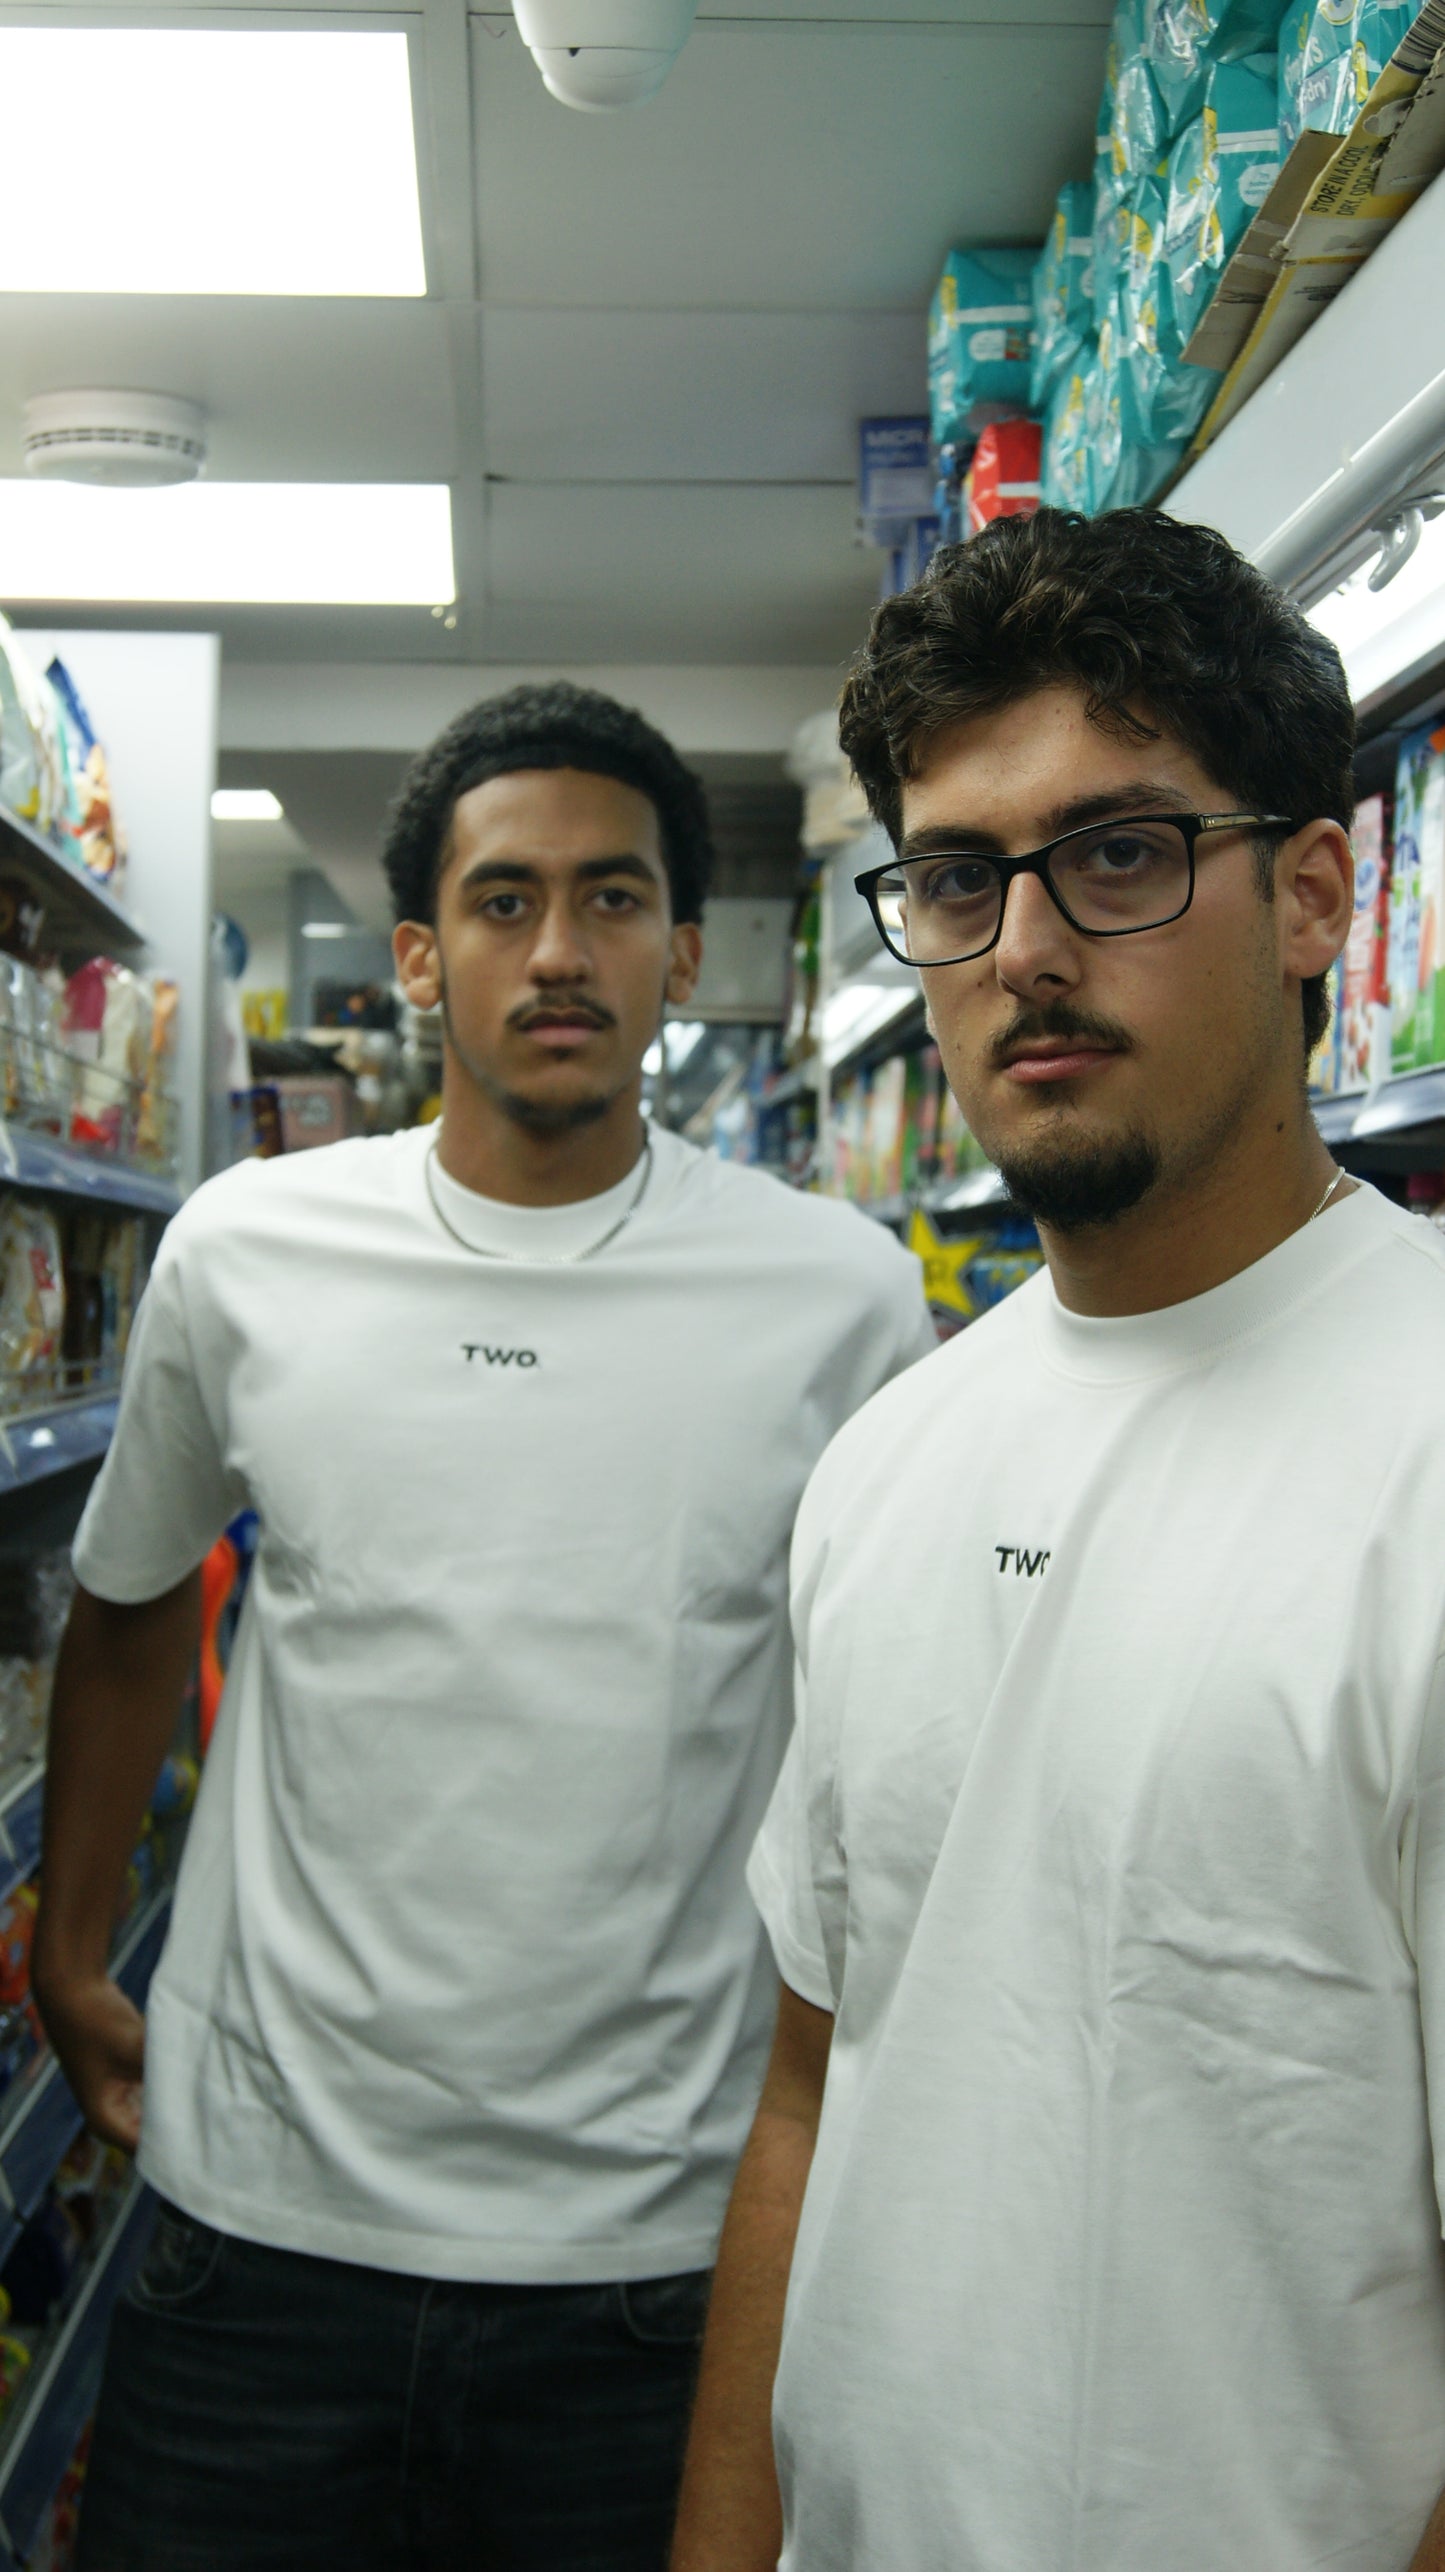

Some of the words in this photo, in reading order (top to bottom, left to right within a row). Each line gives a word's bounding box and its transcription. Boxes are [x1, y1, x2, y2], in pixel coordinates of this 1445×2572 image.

[1338, 145, 1369, 168] COOL
[1328, 174, 1347, 185] IN
[1334, 168, 1354, 177] A
[1310, 183, 1341, 213] STORE
[460, 1344, 537, 1368] TWO
